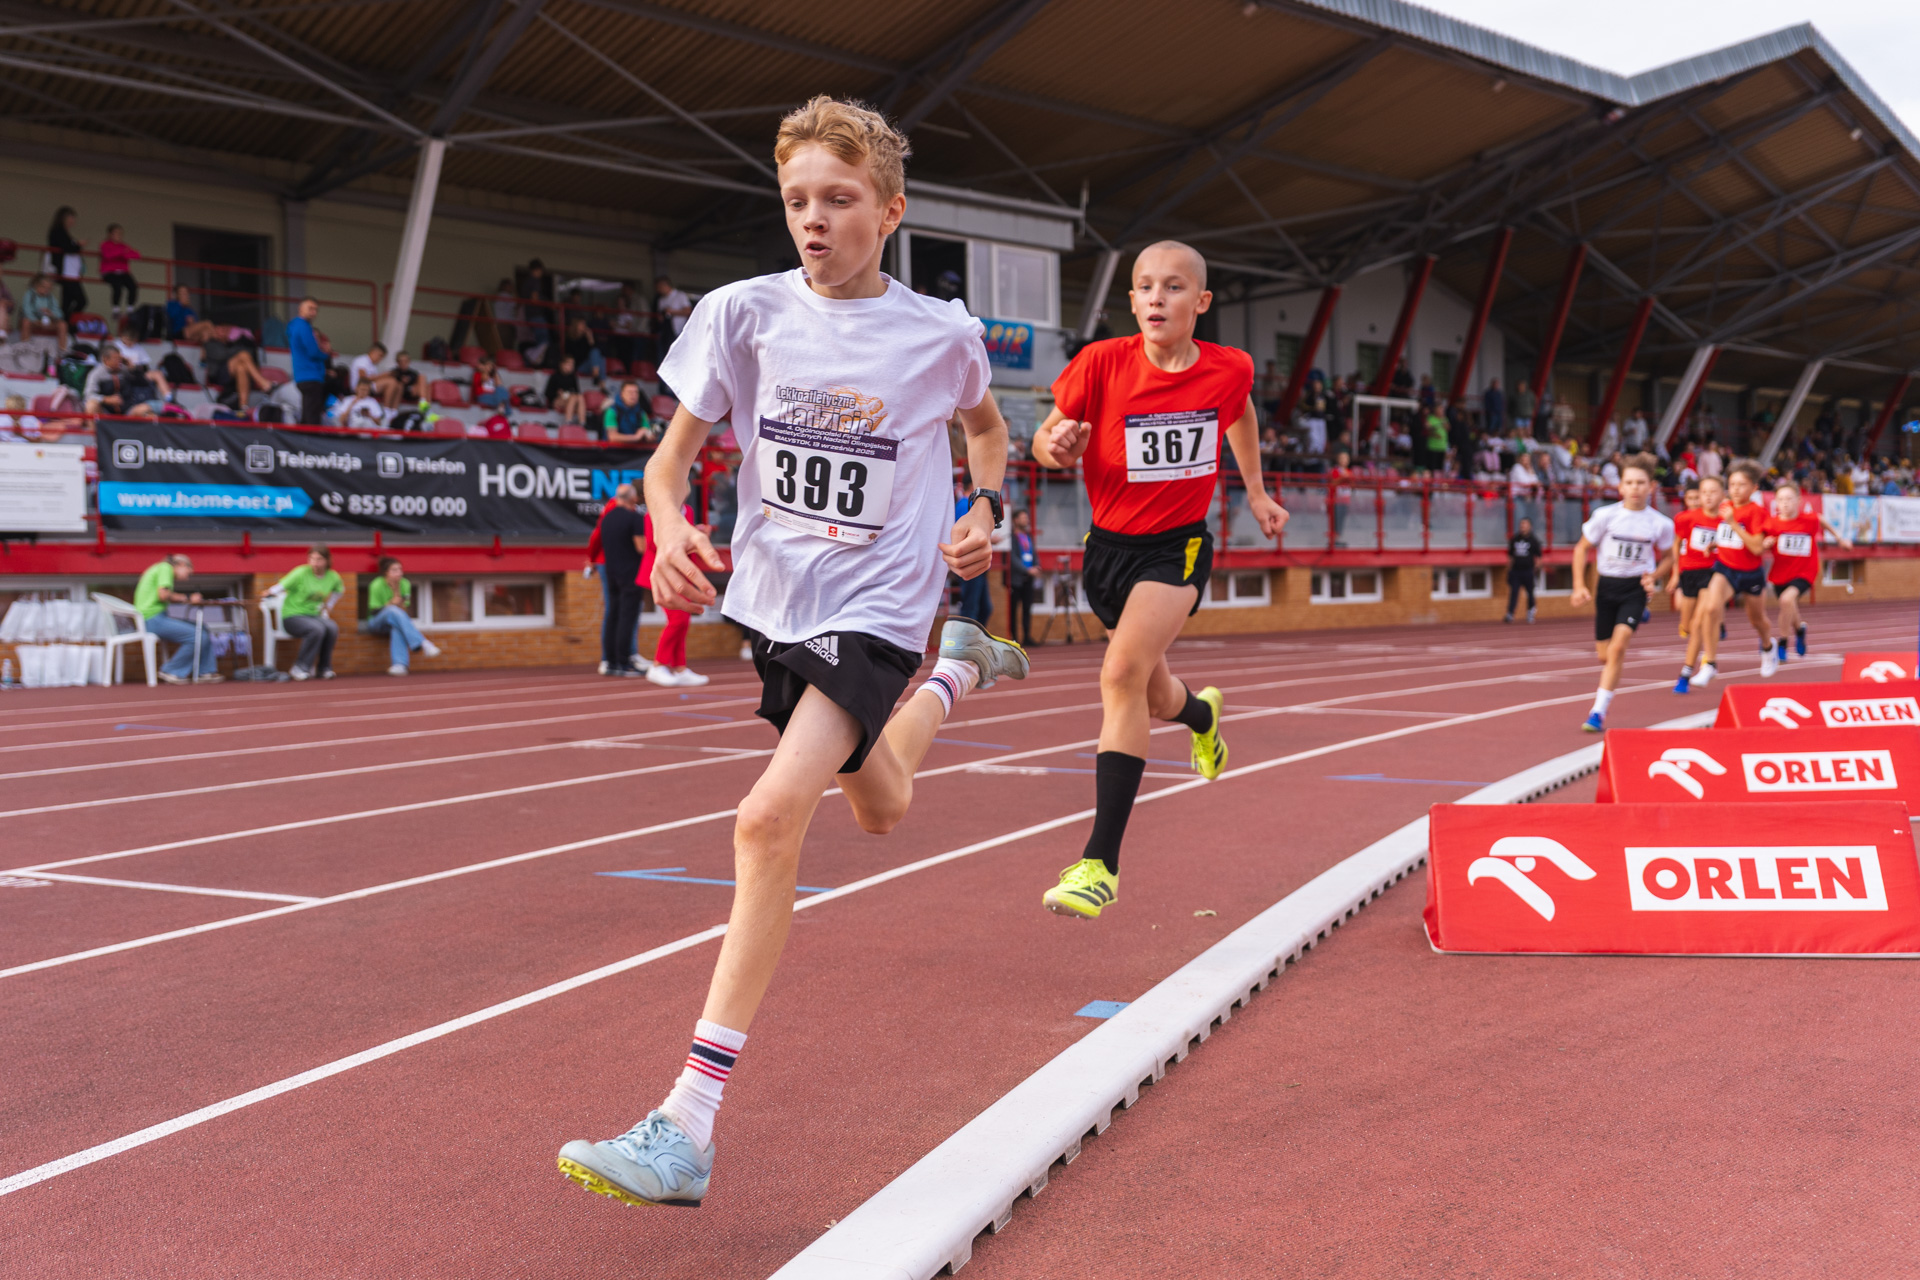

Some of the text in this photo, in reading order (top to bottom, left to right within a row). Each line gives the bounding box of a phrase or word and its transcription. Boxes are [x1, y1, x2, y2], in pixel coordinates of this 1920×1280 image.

[776, 385, 857, 410] Lekkoatletyczne
[763, 425, 893, 451] Lekkoatletycznych Nadziei Olimpijskich
[795, 426, 842, 437] Ogólnopolski
[821, 443, 854, 454] września
[855, 447, 876, 456] 2025
[1142, 427, 1204, 465] 367
[147, 445, 466, 475] Internet Telewizja Telefon
[776, 450, 868, 517] 393
[117, 490, 294, 513] www.home-net.pl
[348, 495, 467, 517] 855 000 000
[804, 640, 840, 666] adidas
[1830, 704, 1914, 723] ORLEN
[1754, 758, 1885, 784] ORLEN
[1642, 857, 1868, 900] ORLEN
